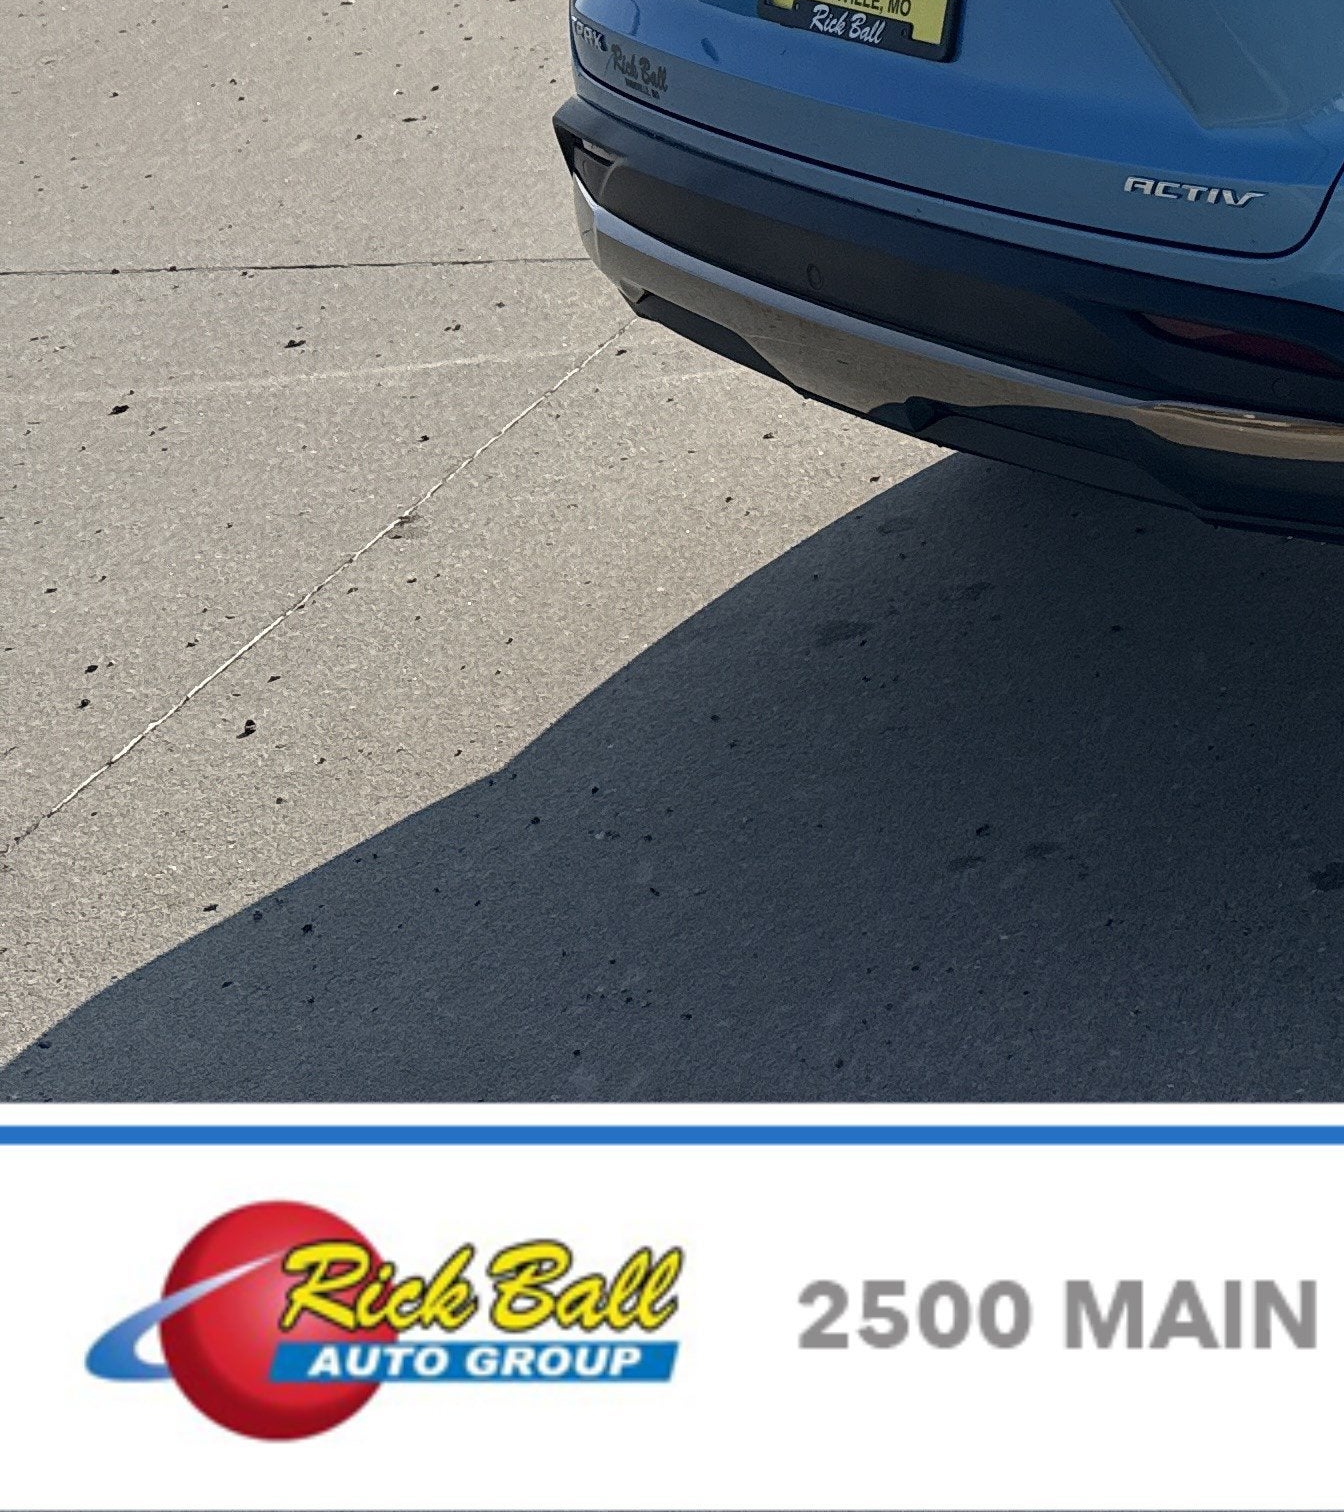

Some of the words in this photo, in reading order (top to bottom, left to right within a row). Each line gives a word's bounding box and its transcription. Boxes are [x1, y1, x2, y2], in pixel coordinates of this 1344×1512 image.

[808, 3, 846, 37] Rick
[849, 13, 887, 45] Ball
[1123, 175, 1269, 208] ACTIV
